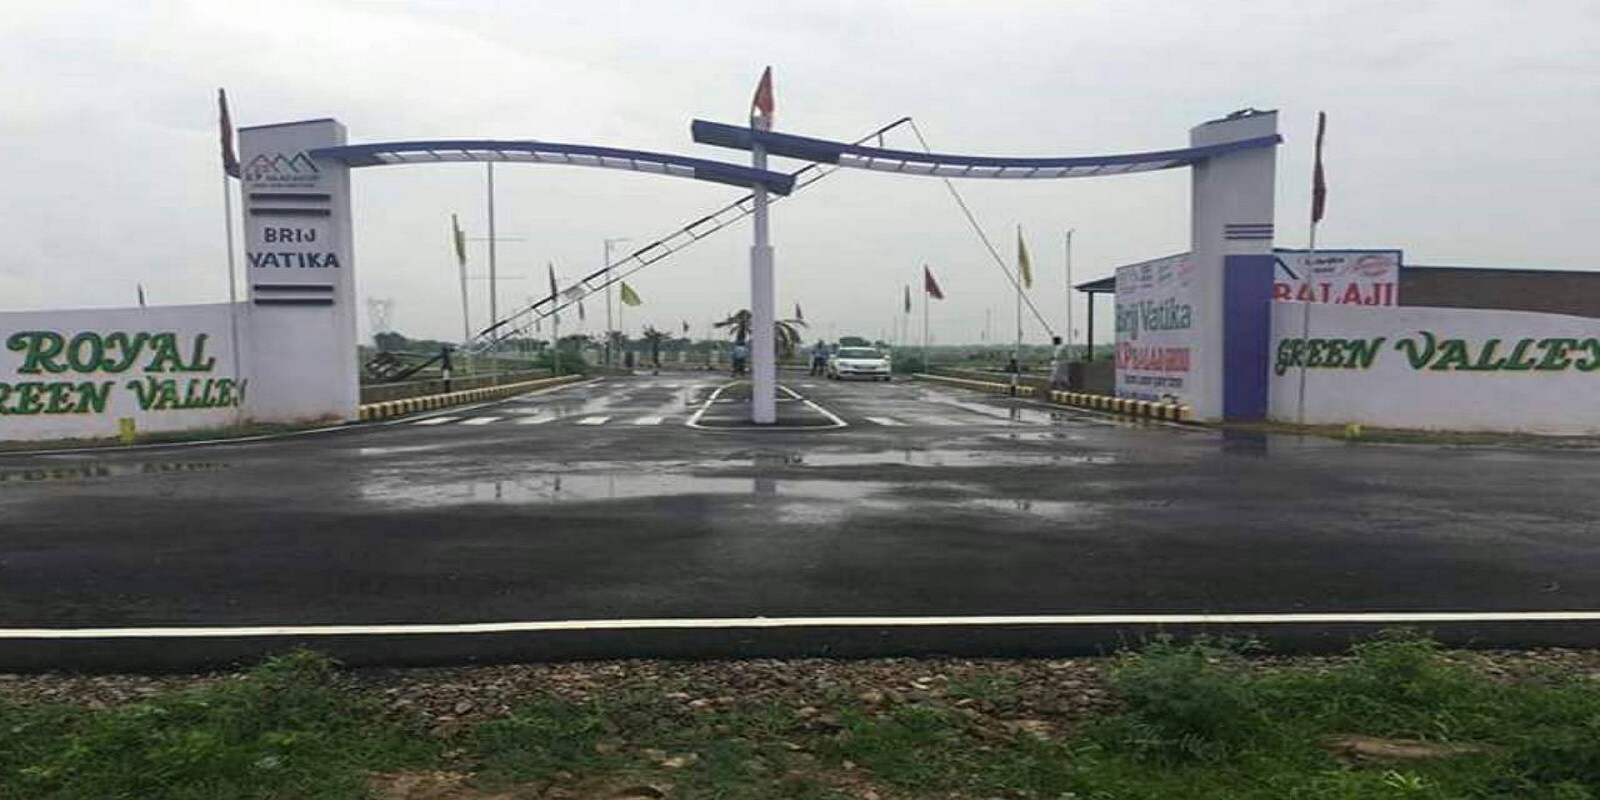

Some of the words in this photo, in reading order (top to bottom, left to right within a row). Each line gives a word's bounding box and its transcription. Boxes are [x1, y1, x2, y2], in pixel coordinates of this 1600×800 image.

[264, 227, 316, 242] BRIJ
[247, 252, 341, 268] VATIKA
[6, 331, 216, 374] ROYAL
[1274, 337, 1387, 376] GREEN
[0, 381, 115, 415] REEN
